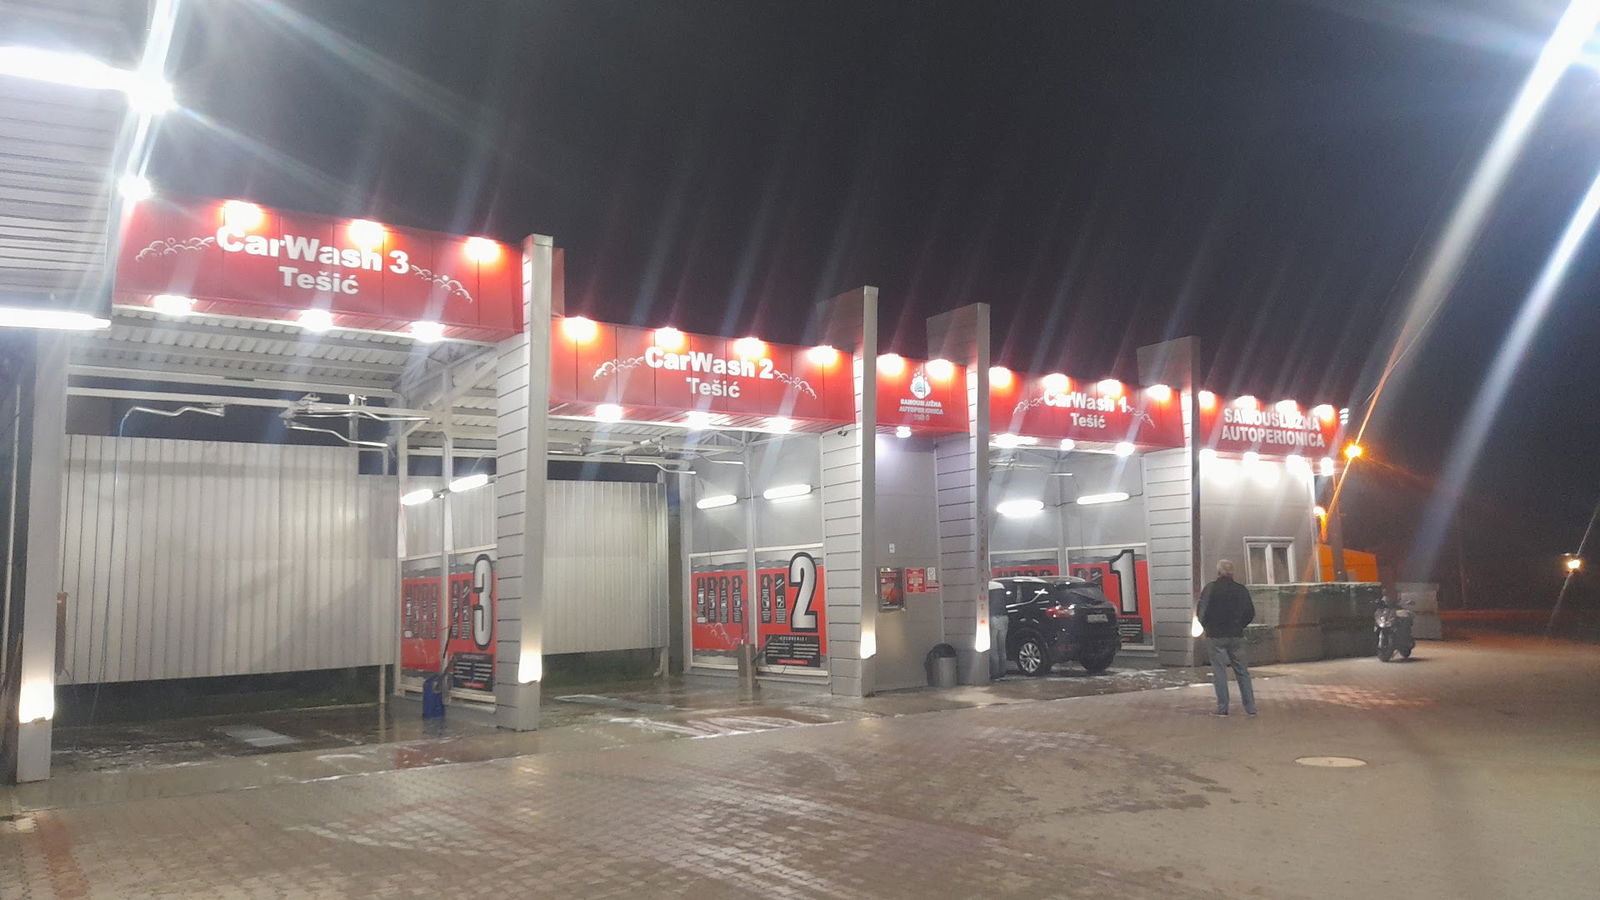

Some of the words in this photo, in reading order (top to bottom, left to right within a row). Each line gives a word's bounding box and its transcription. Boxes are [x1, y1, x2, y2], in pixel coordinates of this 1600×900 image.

[216, 226, 382, 272] CarWash
[389, 250, 409, 274] 3
[278, 266, 359, 295] Tešić
[645, 346, 755, 377] CarWash
[759, 358, 773, 379] 2
[686, 377, 740, 398] Tešić
[1043, 388, 1115, 412] CarWash
[1118, 396, 1127, 413] 1
[1070, 412, 1106, 428] Tešić
[1222, 425, 1325, 448] AUTOPERIONICA
[789, 552, 818, 633] 2
[1110, 549, 1138, 615] 1
[473, 554, 493, 650] 3
